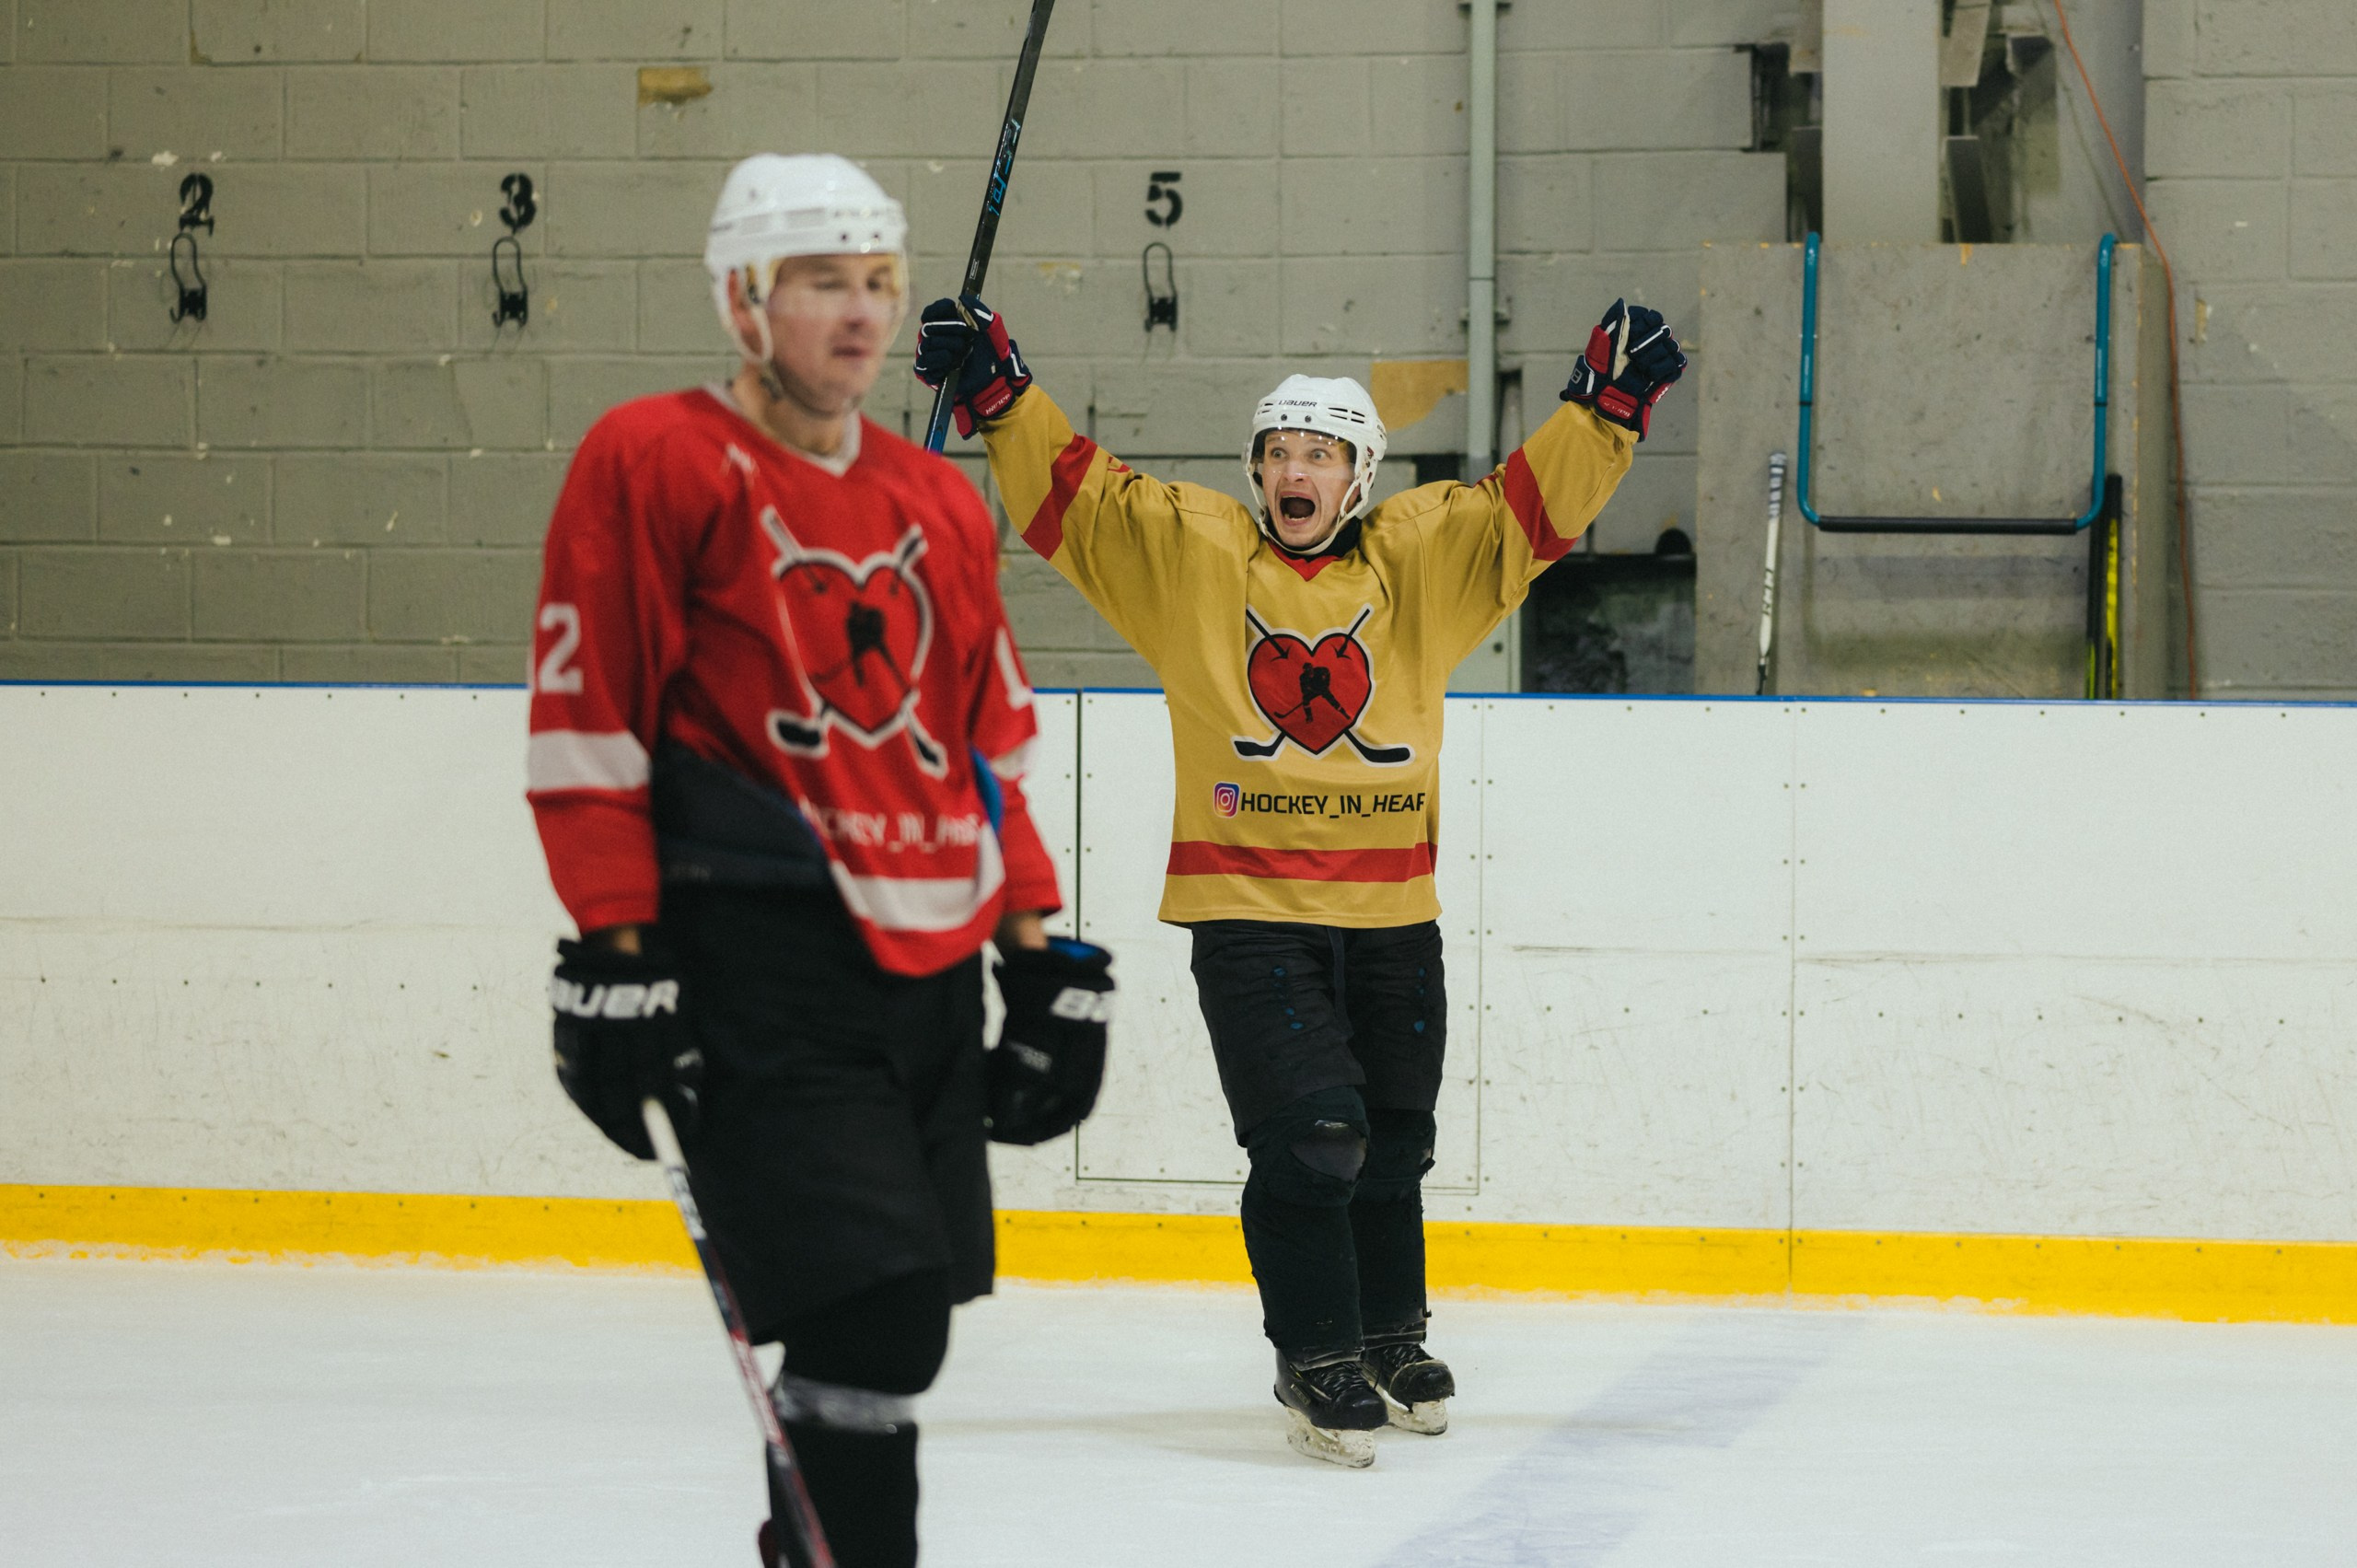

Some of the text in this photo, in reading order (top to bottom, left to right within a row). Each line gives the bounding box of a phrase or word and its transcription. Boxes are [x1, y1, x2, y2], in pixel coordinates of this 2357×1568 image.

[180, 172, 215, 234] 2
[500, 172, 536, 230] 3
[1145, 171, 1183, 229] 5
[528, 602, 584, 692] 2
